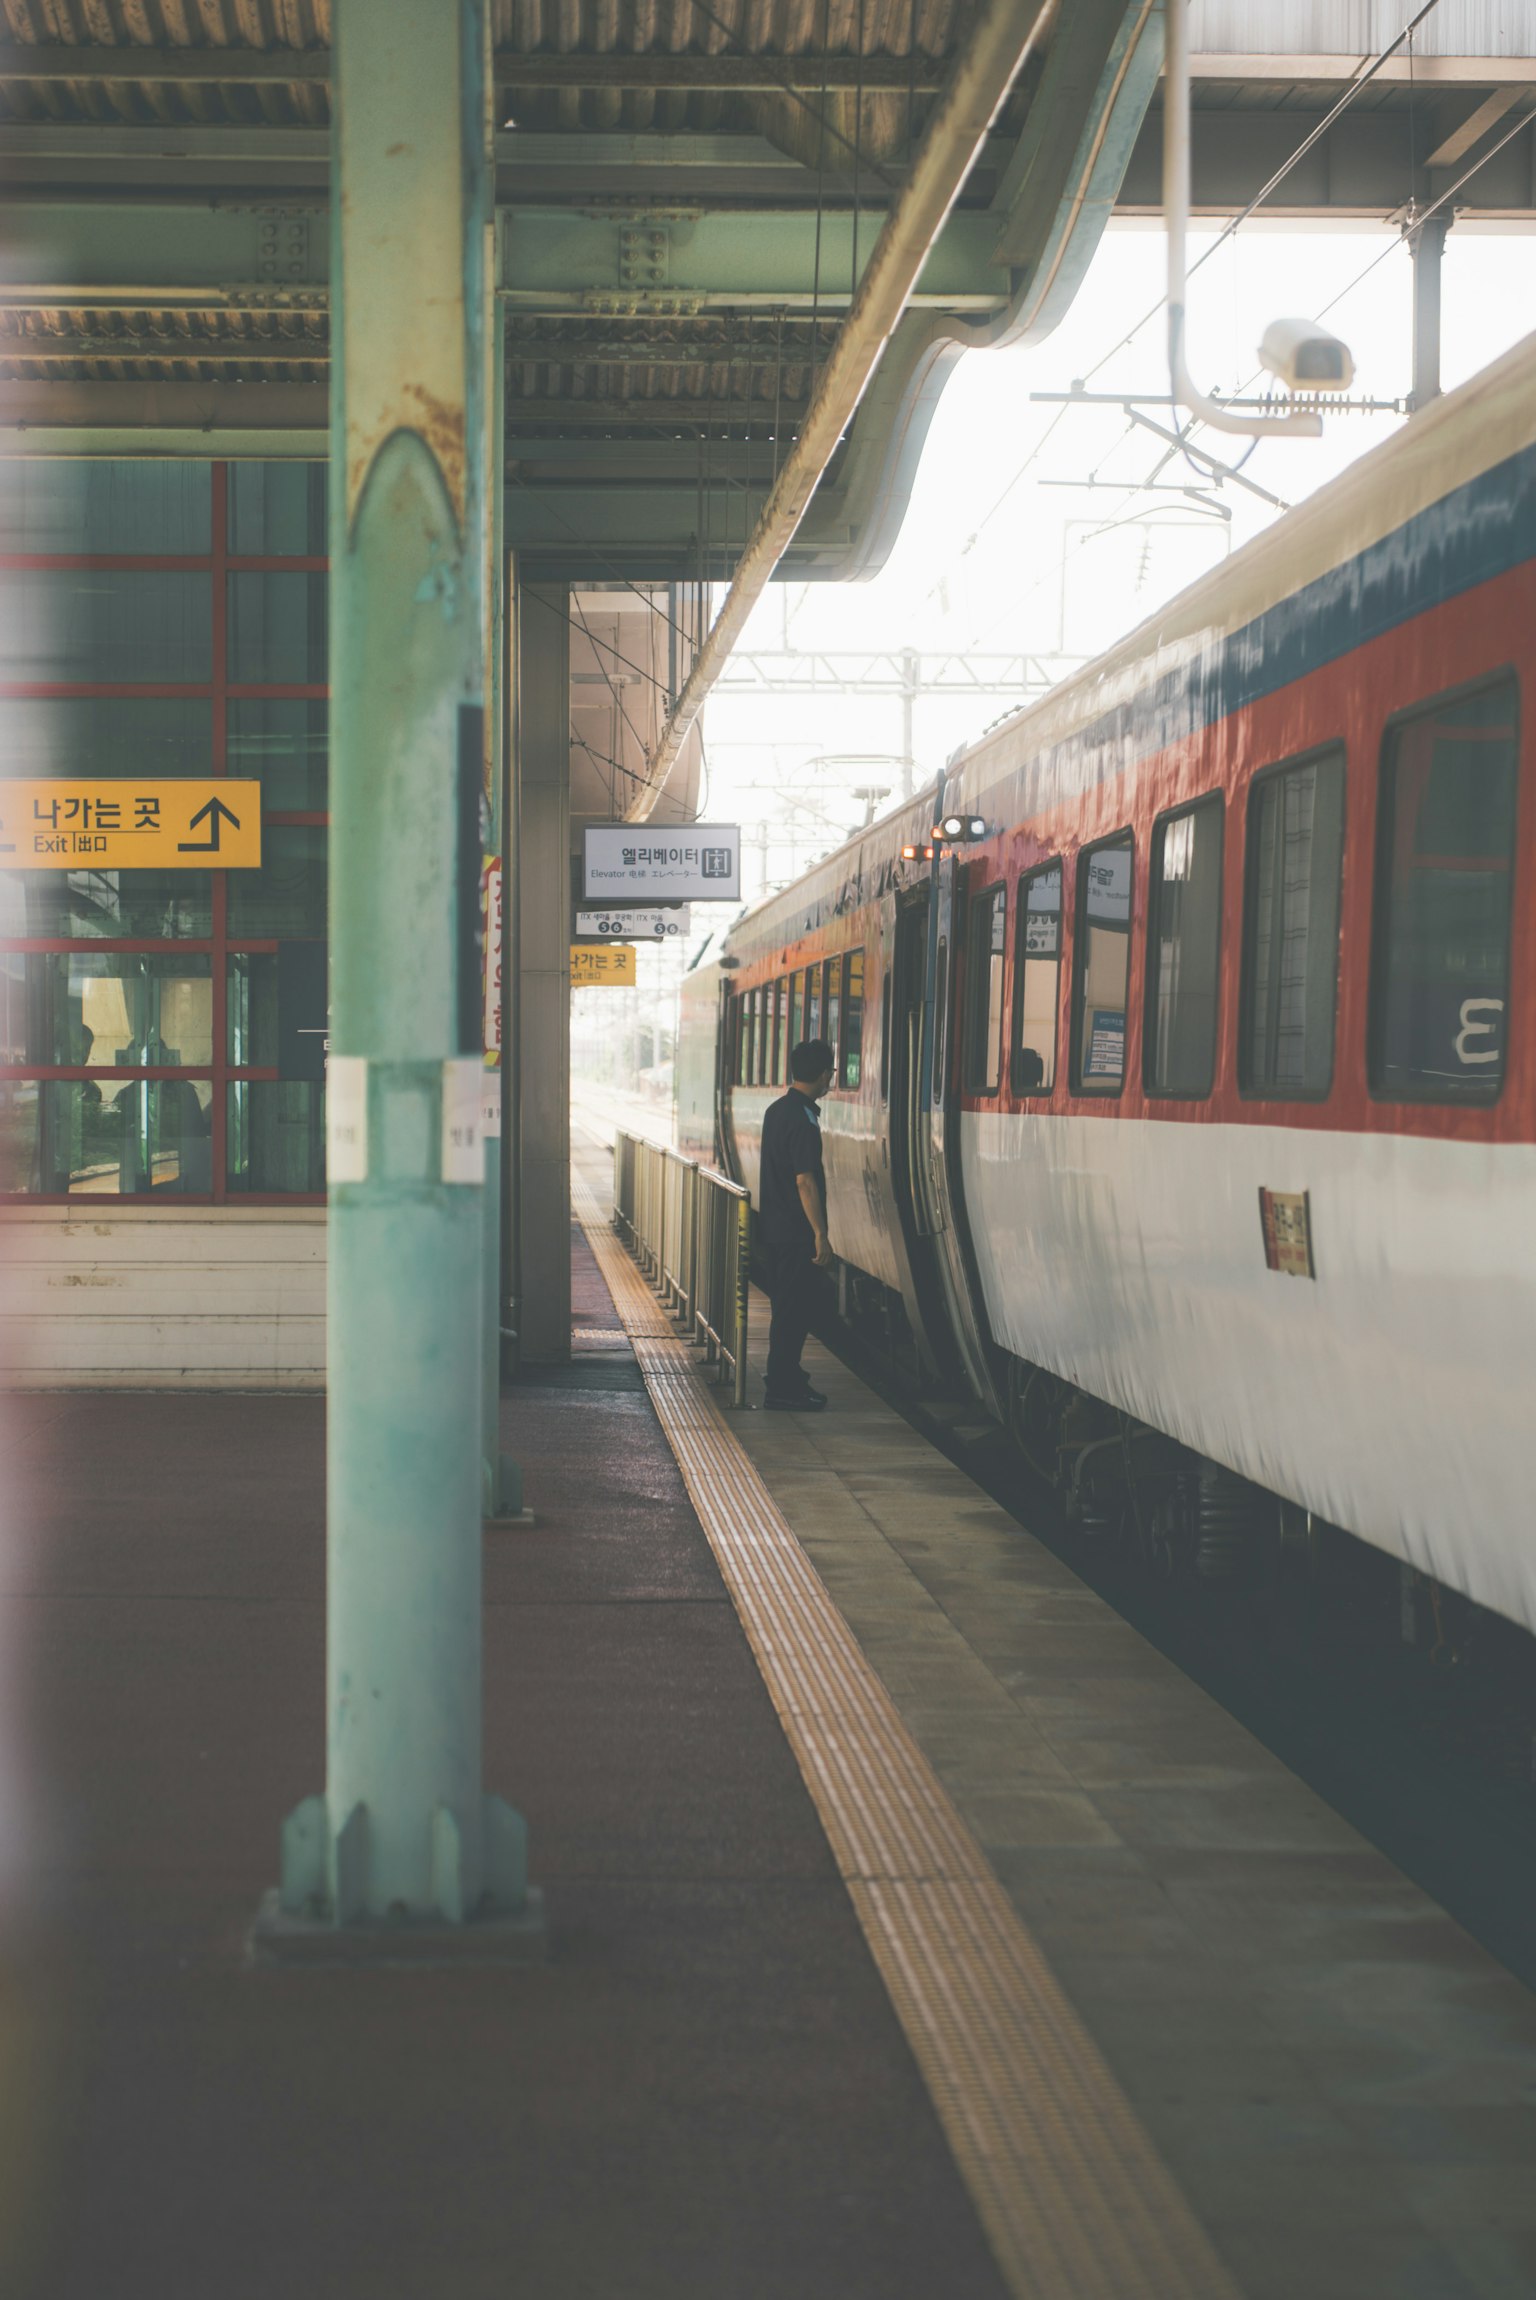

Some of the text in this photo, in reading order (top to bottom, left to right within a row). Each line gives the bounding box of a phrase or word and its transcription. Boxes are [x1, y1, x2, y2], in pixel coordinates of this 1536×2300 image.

[33, 798, 160, 829] 나가는 곳
[34, 835, 68, 853] Exit
[78, 835, 107, 853] 出口
[622, 848, 699, 865] 엘리베이터
[591, 870, 625, 878] Elevator
[651, 870, 698, 879] エレベーター
[614, 953, 626, 969] 곳
[570, 972, 582, 980] xit
